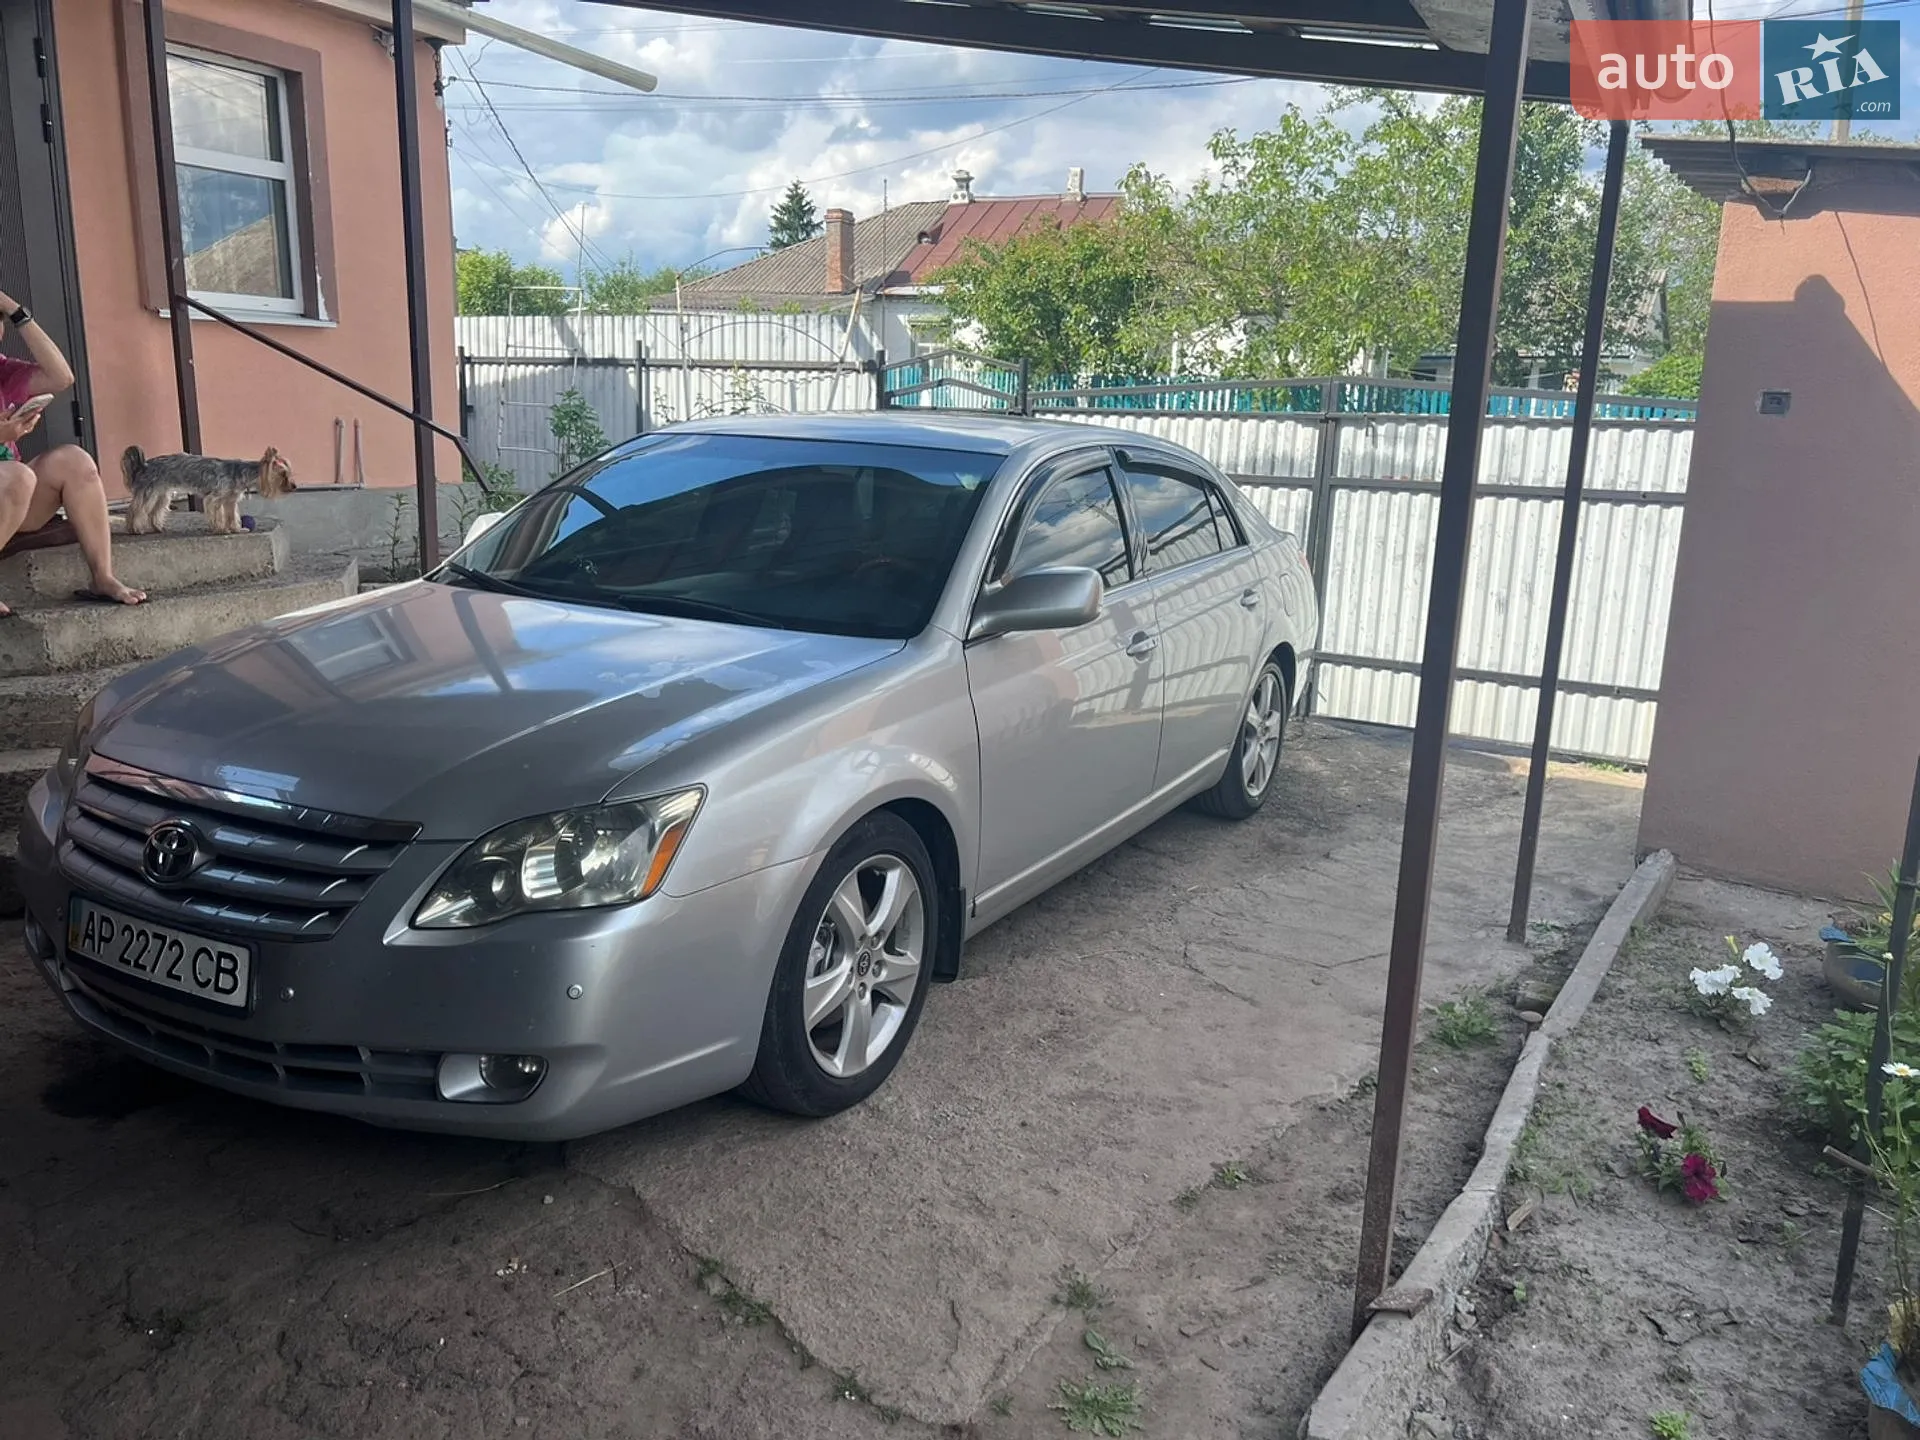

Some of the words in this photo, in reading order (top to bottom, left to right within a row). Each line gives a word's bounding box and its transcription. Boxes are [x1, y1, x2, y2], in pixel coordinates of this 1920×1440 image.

[82, 911, 115, 954] AP
[118, 924, 184, 982] 2272
[192, 946, 239, 995] CB
